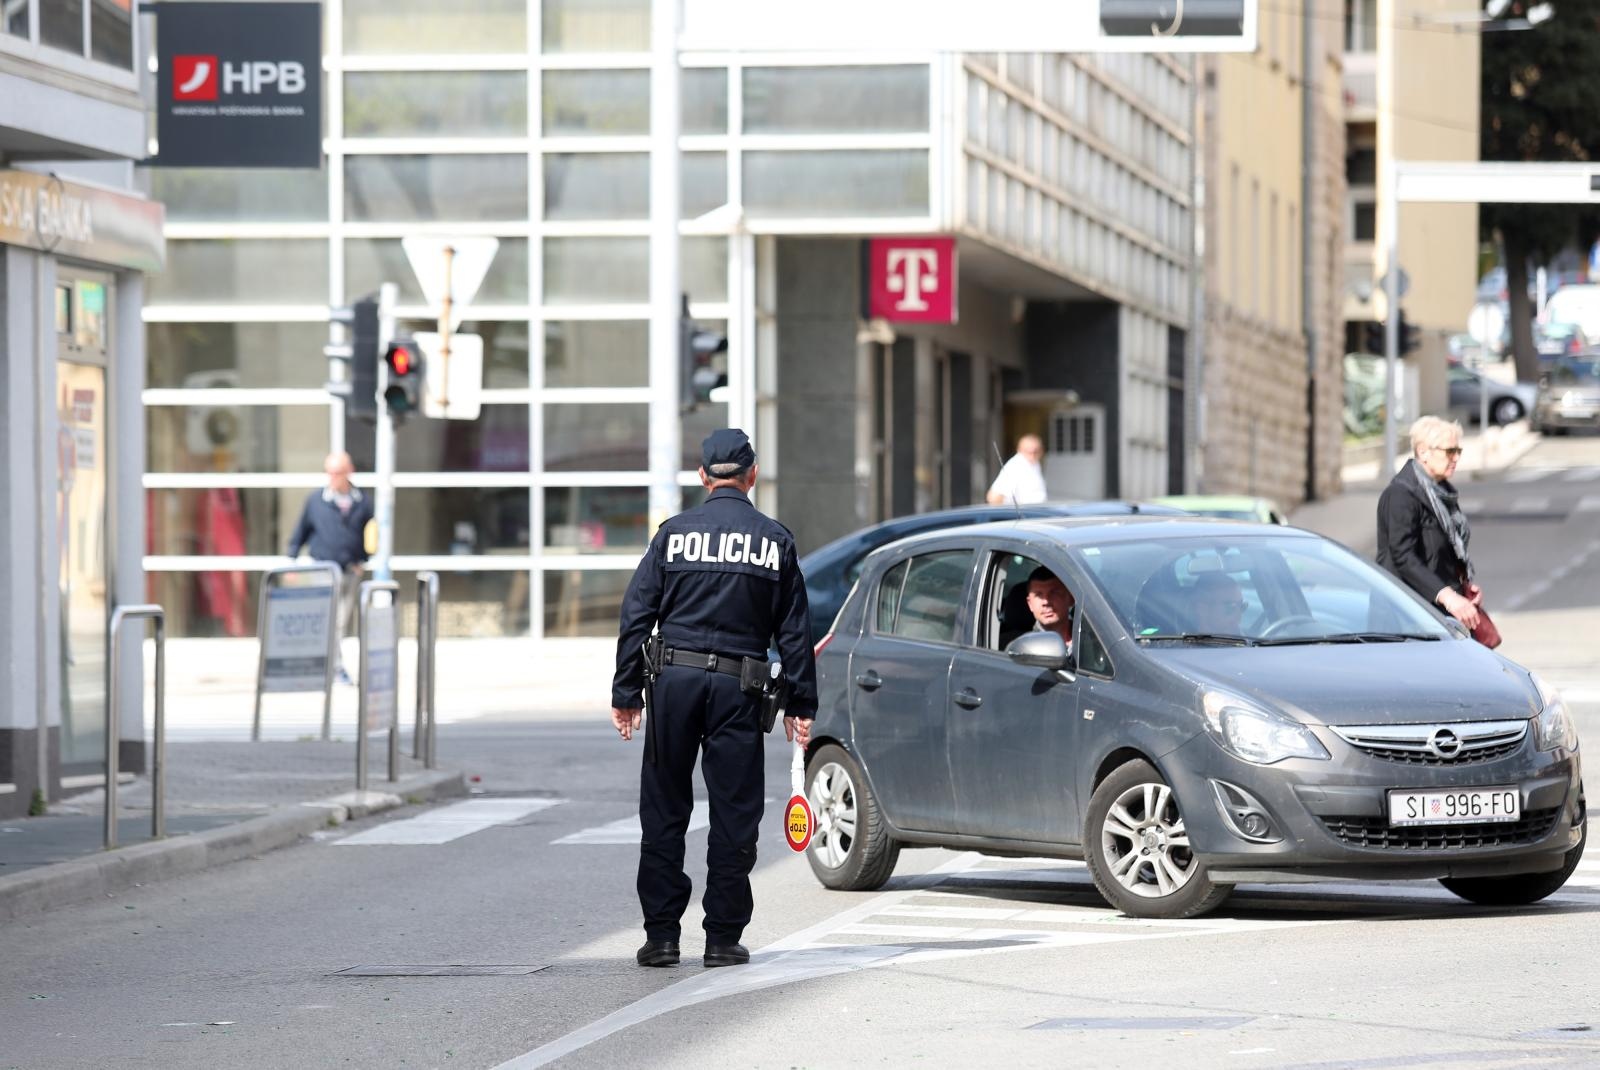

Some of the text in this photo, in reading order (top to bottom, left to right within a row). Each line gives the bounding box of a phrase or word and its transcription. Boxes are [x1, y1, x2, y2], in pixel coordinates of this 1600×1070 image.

[223, 61, 306, 94] HPB
[886, 248, 938, 312] T
[667, 531, 780, 571] POLICIJA
[1445, 792, 1515, 817] 996-FO
[790, 823, 807, 832] STOP
